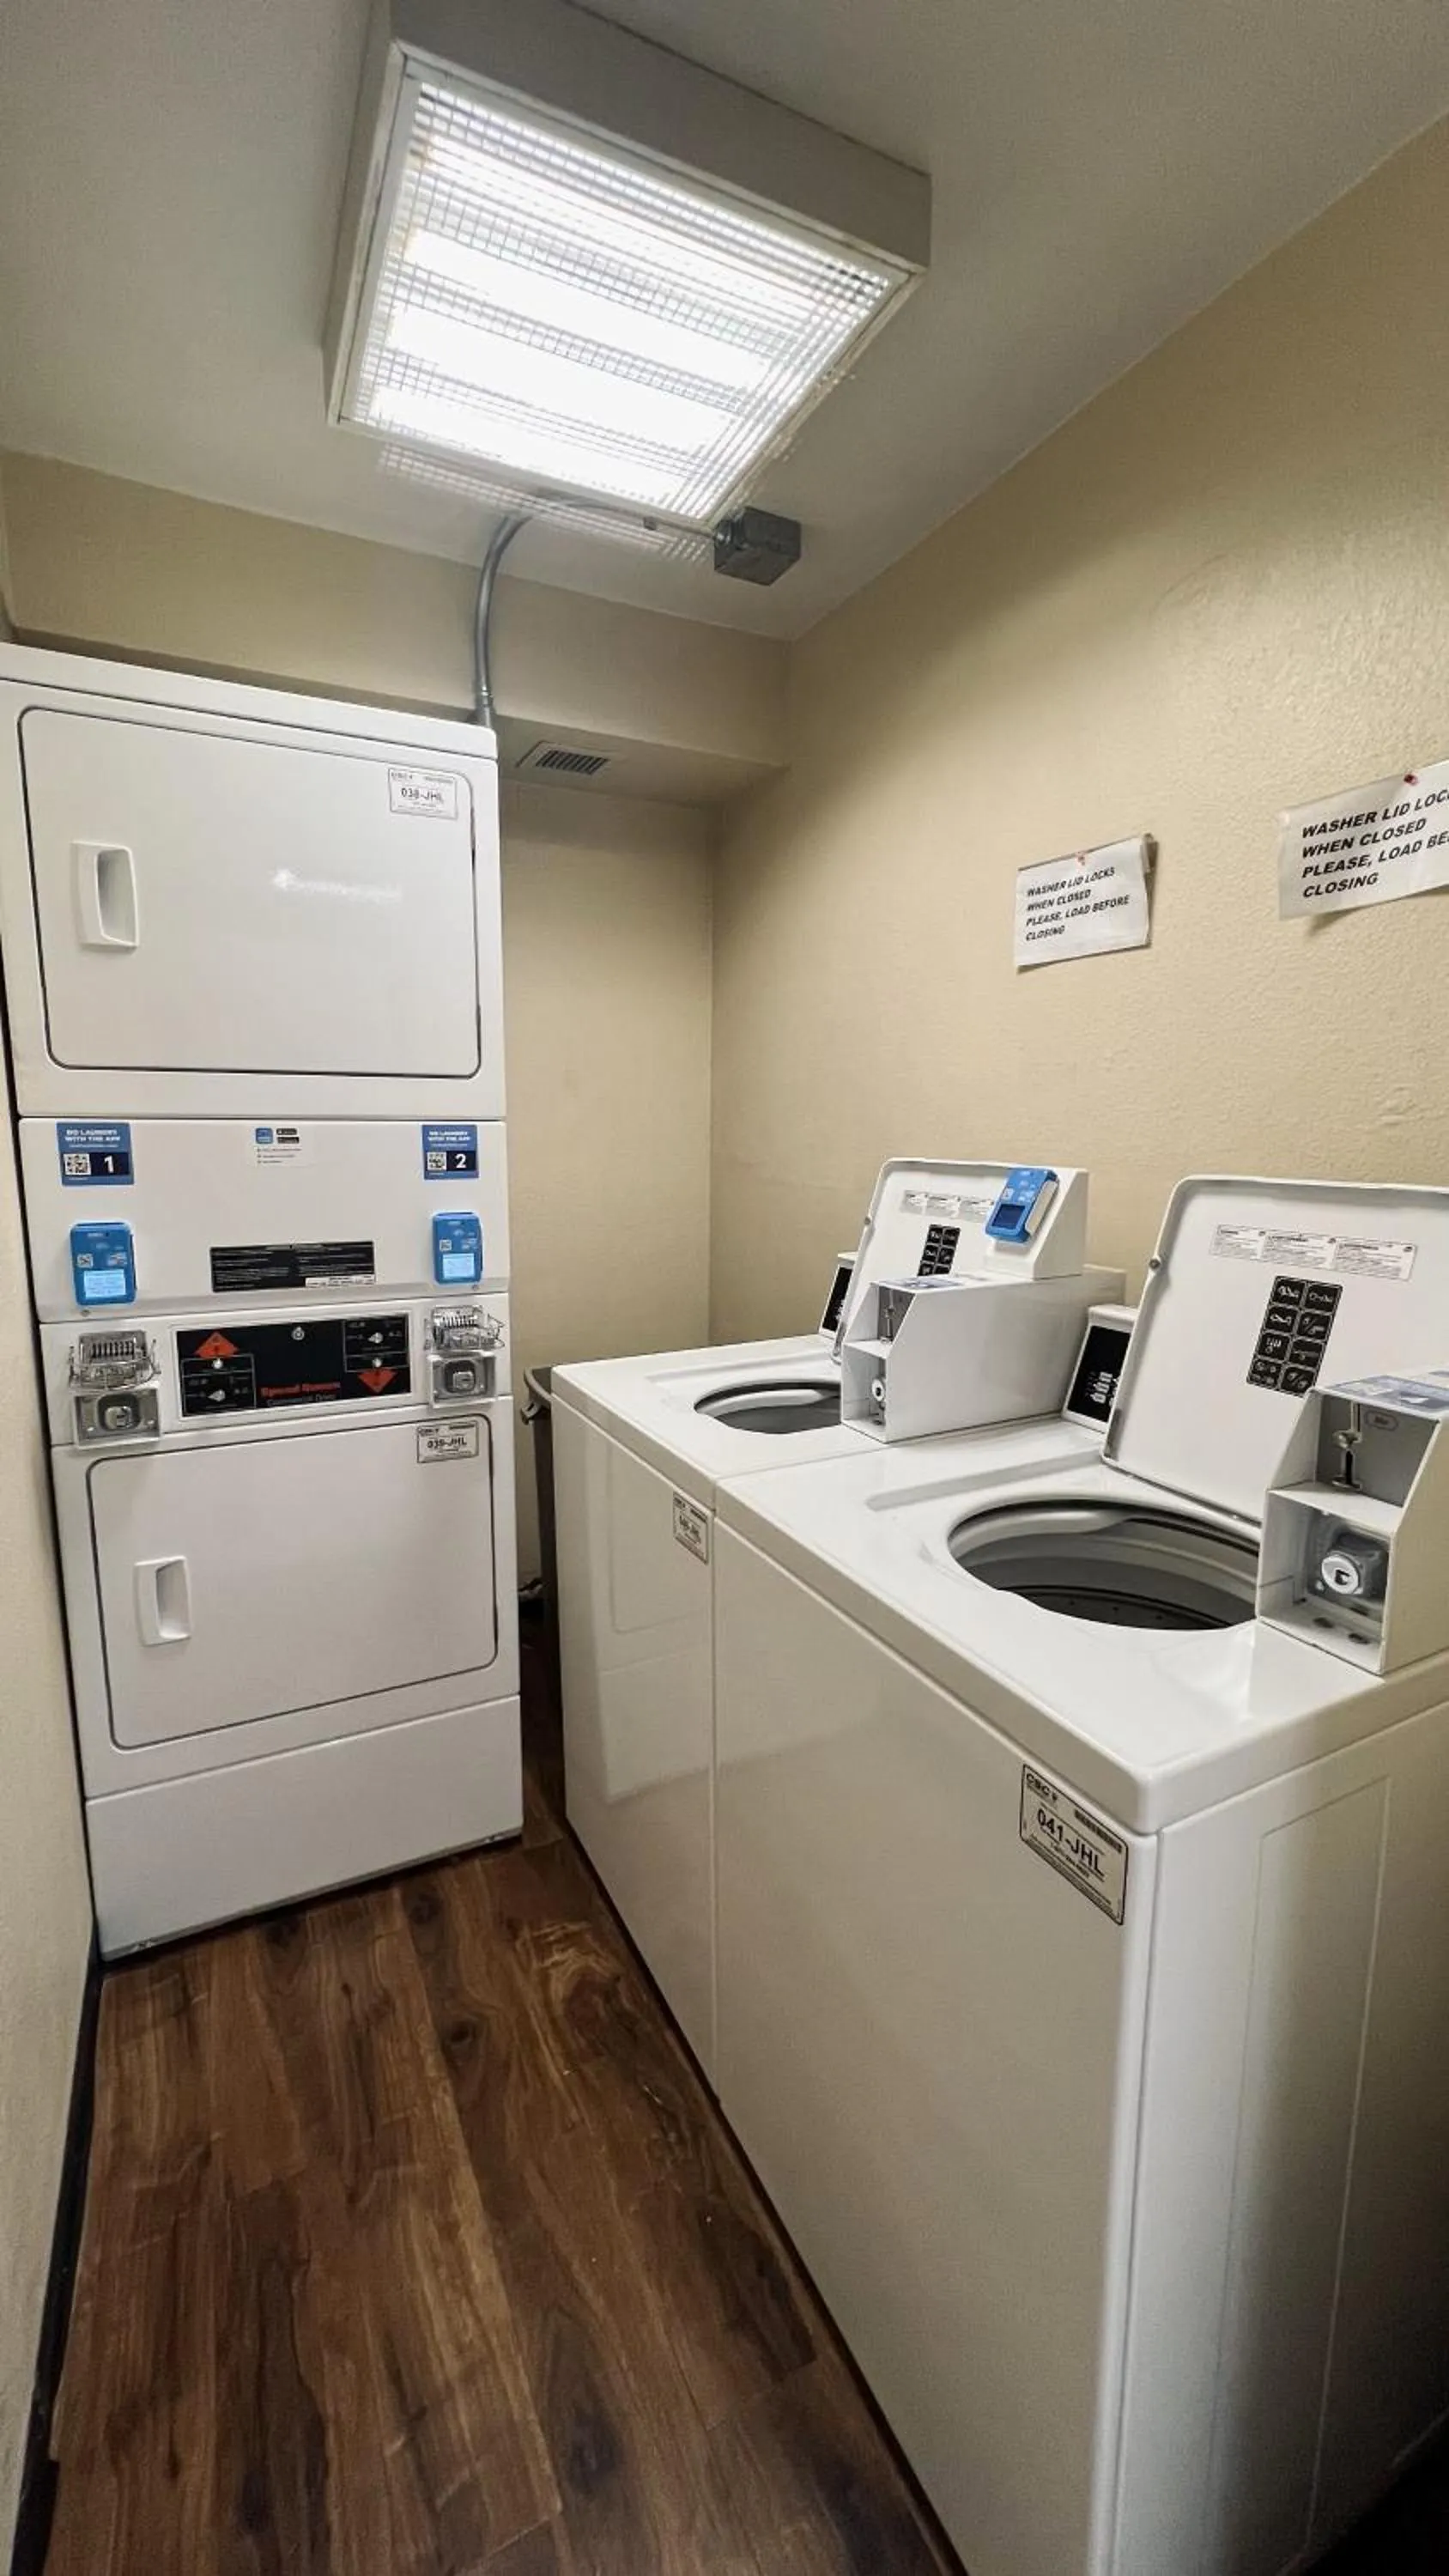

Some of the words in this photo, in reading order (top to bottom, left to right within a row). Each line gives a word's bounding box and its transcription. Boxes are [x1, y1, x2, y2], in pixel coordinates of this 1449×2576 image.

[1302, 811, 1378, 839] WASHER
[1381, 803, 1411, 821] LID
[1414, 789, 1449, 811] LOC
[1302, 837, 1355, 859] WHEN
[1359, 817, 1428, 847] CLOSED
[1301, 854, 1373, 879] PLEASE,
[1378, 841, 1423, 863] LOAD
[1426, 830, 1449, 850] BE
[1028, 880, 1067, 897] WASHER
[1067, 875, 1083, 889] LID
[1084, 866, 1116, 884] LOCKS
[1302, 872, 1379, 898] CLOSING
[1027, 898, 1055, 912] WHEN
[1057, 889, 1091, 906] CLOSED
[1065, 904, 1091, 918] LOAD
[1091, 894, 1131, 913] BEFORE
[1025, 925, 1065, 941] CLOSING
[104, 1155, 114, 1174] 1
[455, 1153, 467, 1169] 2
[1038, 1808, 1105, 1877] 041-JHL
